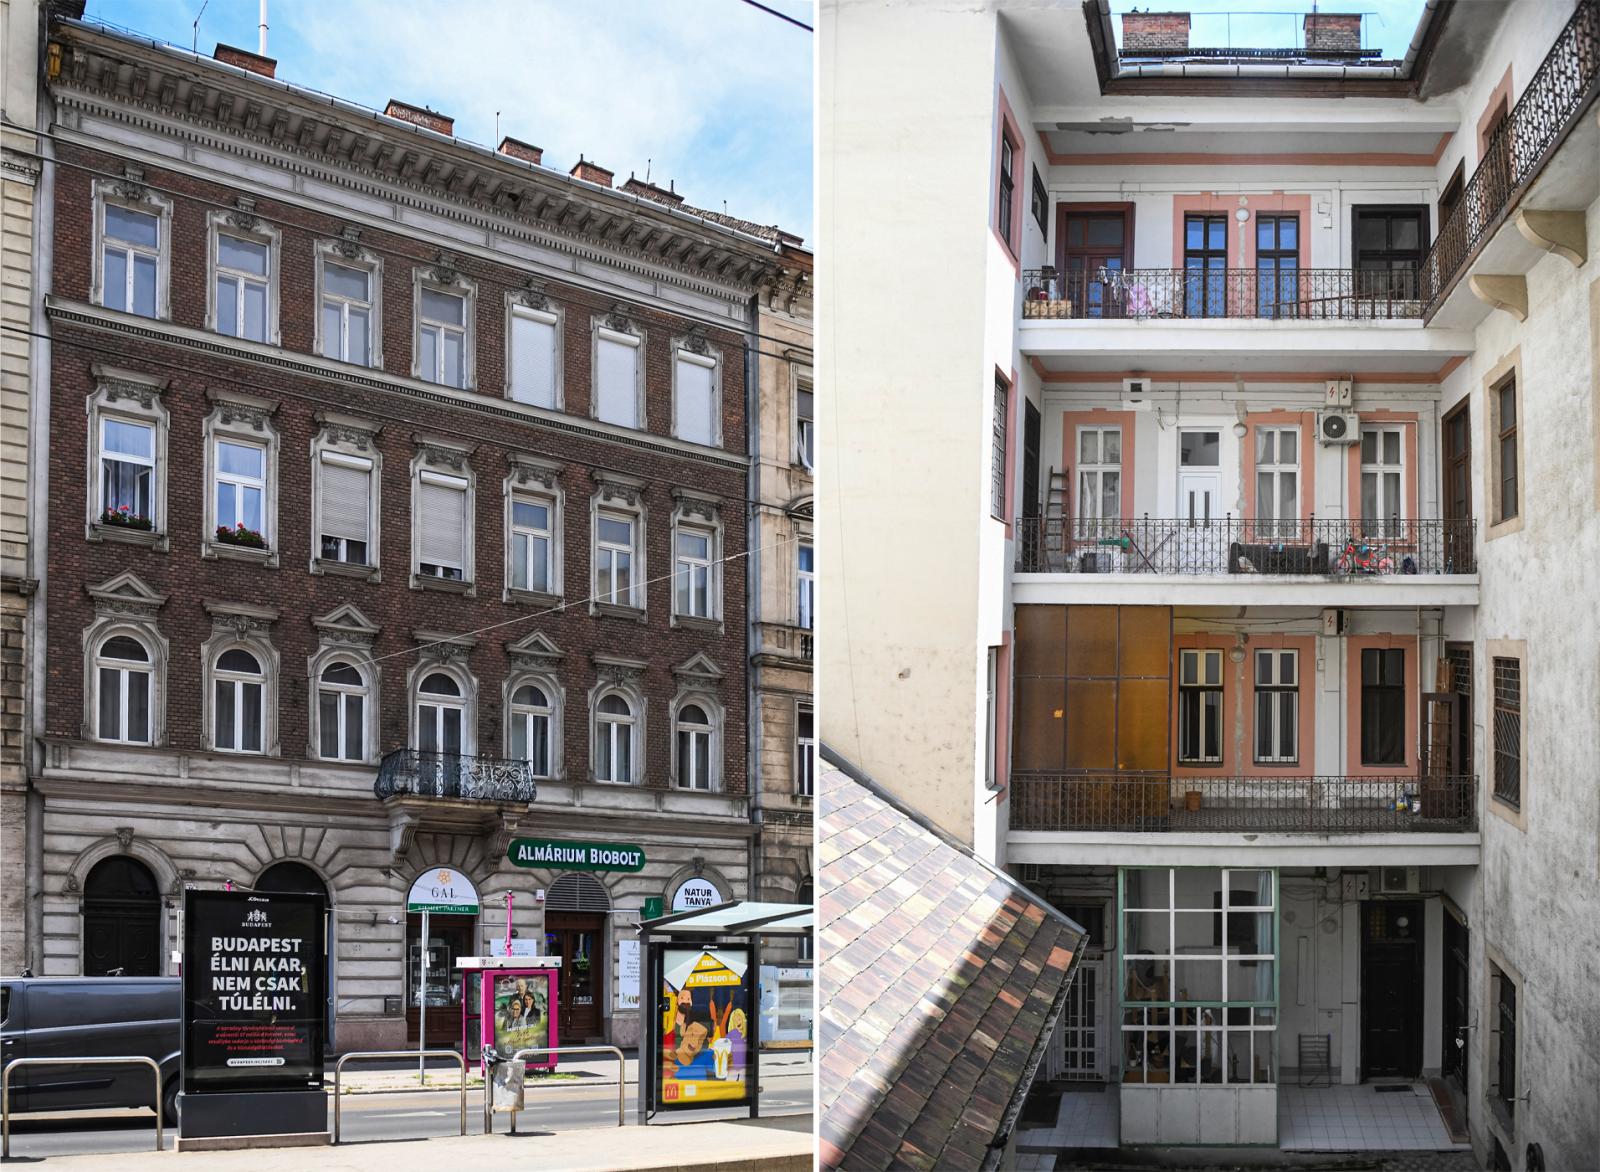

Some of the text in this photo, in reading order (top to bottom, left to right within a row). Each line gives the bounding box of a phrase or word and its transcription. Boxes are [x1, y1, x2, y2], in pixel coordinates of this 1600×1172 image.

[518, 844, 640, 866] ALMÁRIUM BIOBOLT
[684, 888, 712, 897] NATUR
[211, 937, 302, 953] BUDAPEST
[210, 952, 306, 975] ÉLNI AKAR,
[212, 976, 301, 991] NEM CSAK
[218, 991, 297, 1011] TÚLÉLNI.
